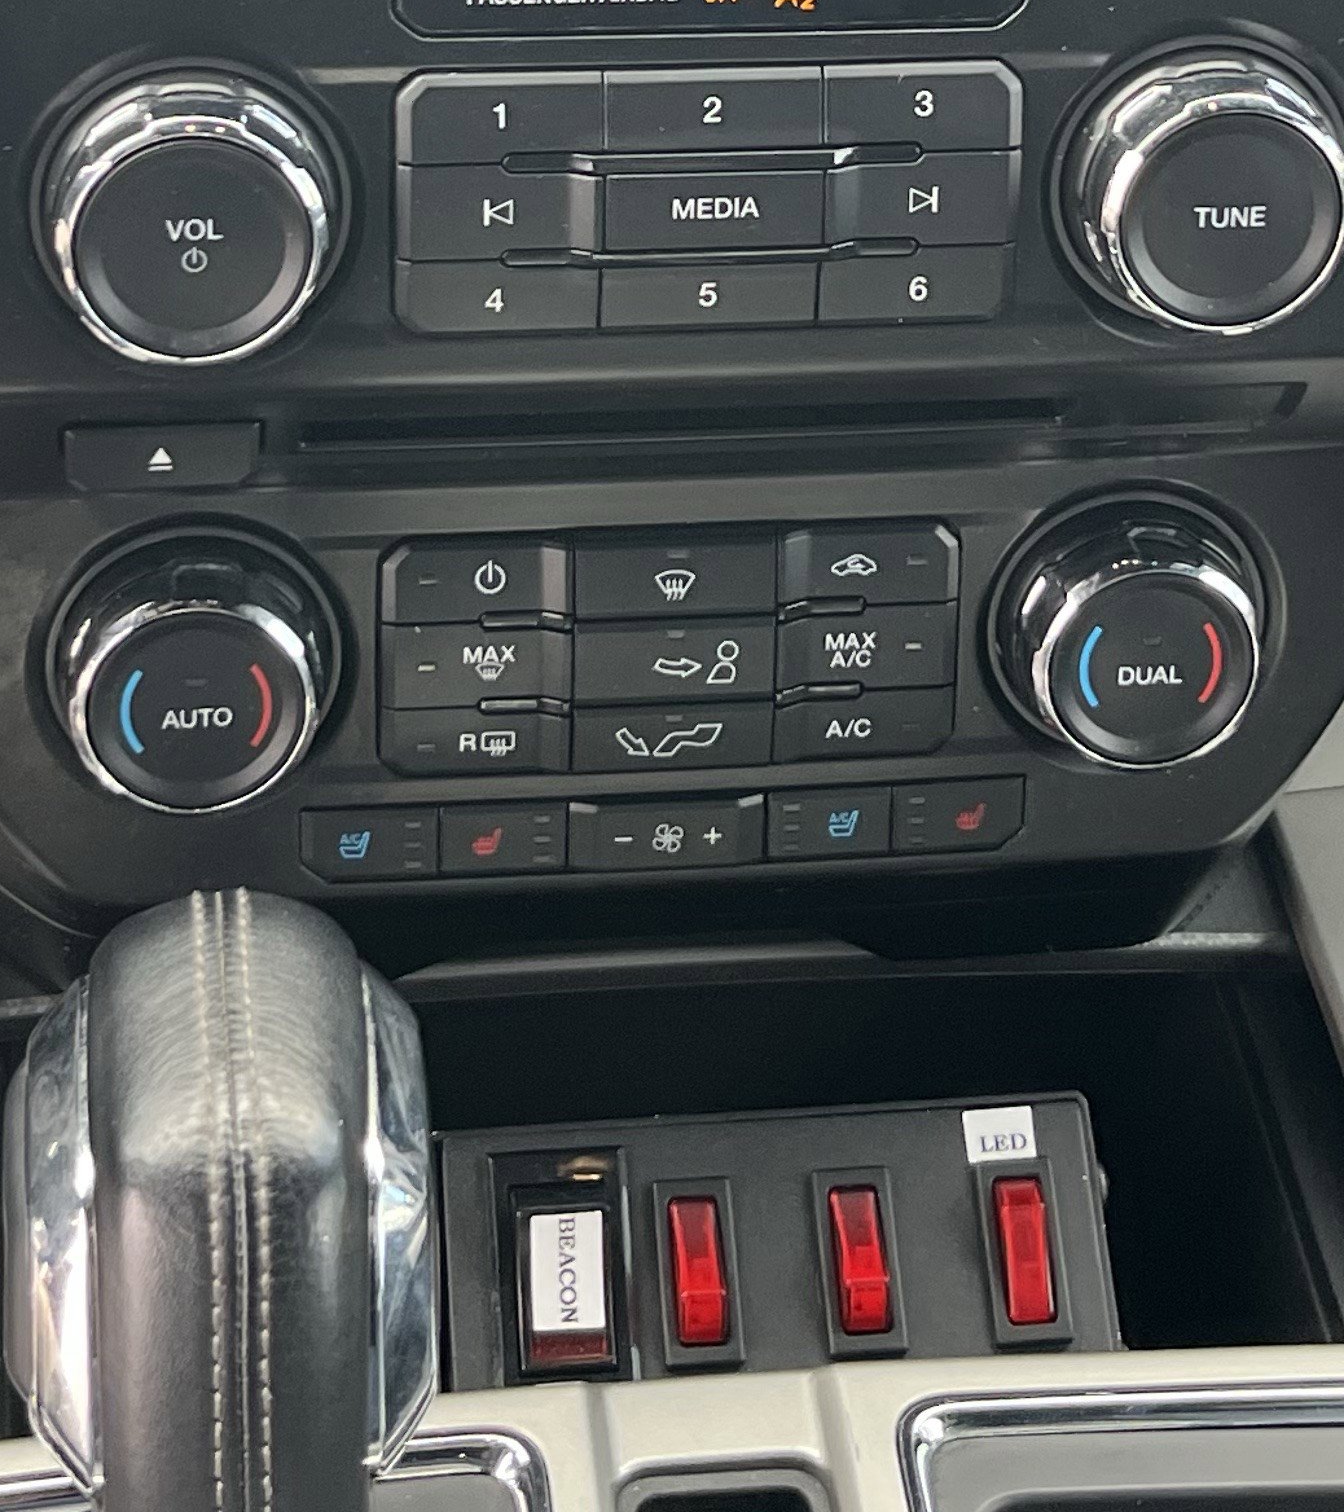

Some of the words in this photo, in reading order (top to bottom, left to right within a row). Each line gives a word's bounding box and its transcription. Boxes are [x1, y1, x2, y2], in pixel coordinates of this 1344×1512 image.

[492, 103, 508, 129] 1
[702, 97, 723, 124] 2
[913, 91, 935, 118] 3
[671, 196, 761, 222] MEDIA
[1193, 205, 1268, 230] TUNE
[164, 218, 225, 243] VOL
[484, 289, 505, 313] 4
[698, 283, 718, 308] 5
[909, 276, 929, 302] 6
[824, 631, 877, 651] MAX
[462, 644, 516, 664] MAX
[829, 649, 873, 669] A/C
[1117, 664, 1183, 687] DUAL
[161, 706, 233, 730] AUTO
[825, 718, 873, 740] A/C
[459, 733, 476, 753] R
[979, 1132, 1029, 1153] LED
[558, 1217, 580, 1324] BEACON
